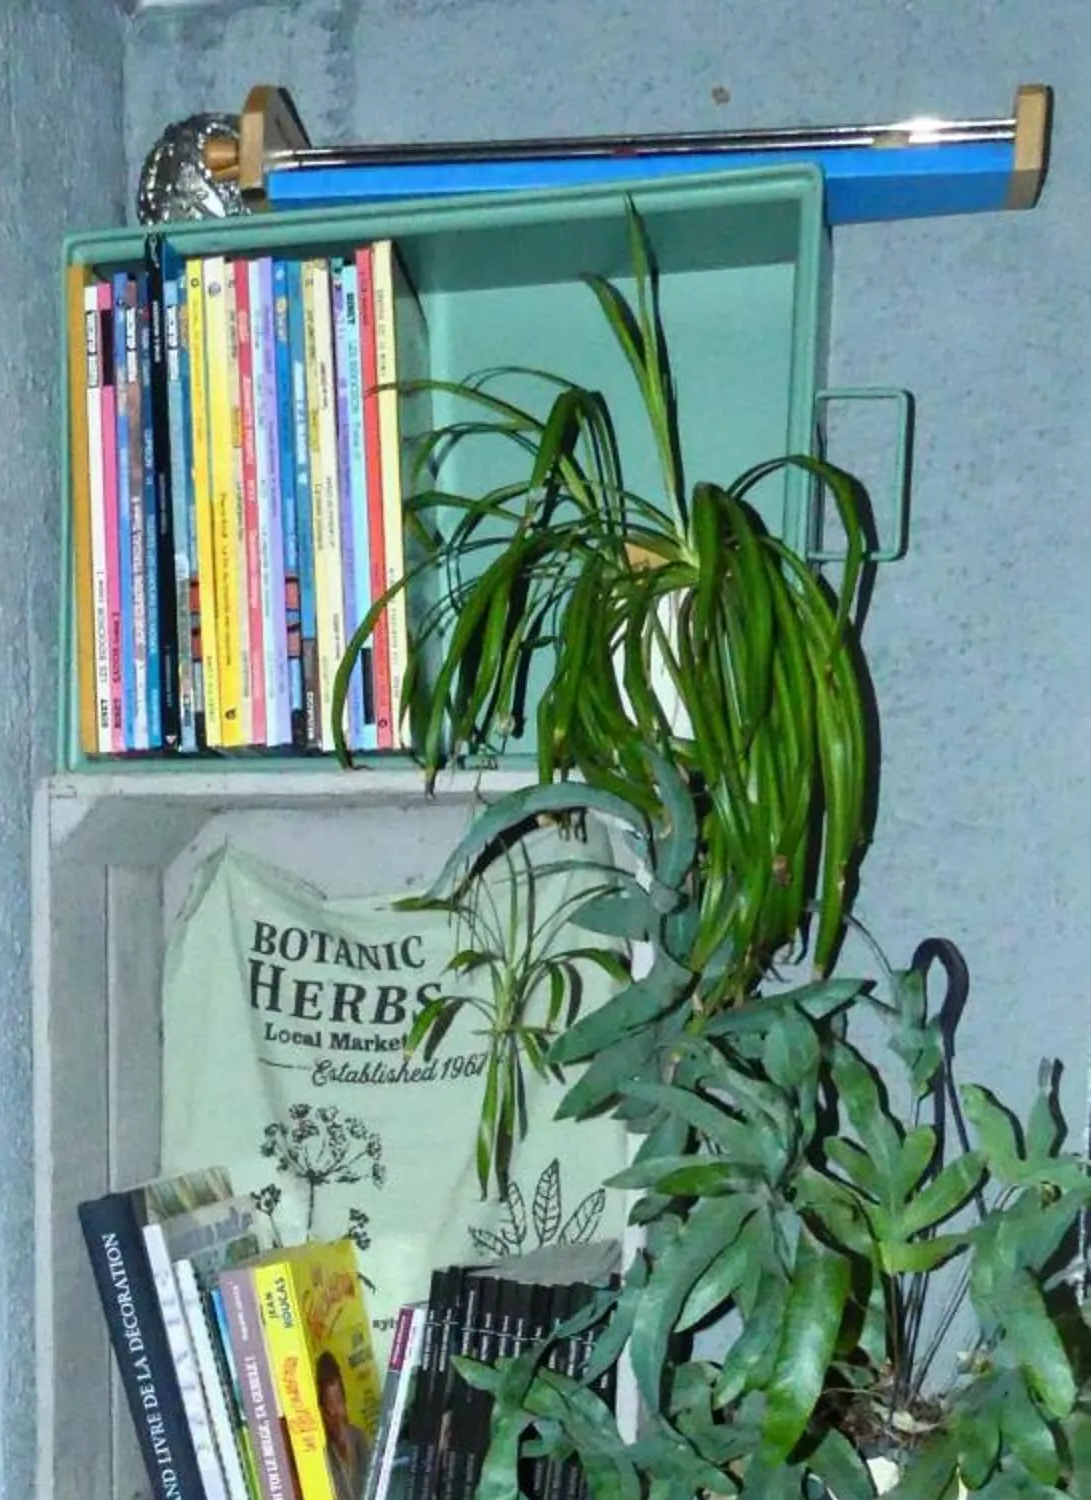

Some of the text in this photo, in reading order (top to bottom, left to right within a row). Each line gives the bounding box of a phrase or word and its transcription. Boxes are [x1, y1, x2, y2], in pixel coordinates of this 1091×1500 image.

[249, 919, 426, 971] BOTANIC
[248, 958, 443, 1025] HERBS
[264, 1022, 408, 1053] Local Market
[312, 1052, 489, 1087] Established 1967
[265, 1292, 279, 1319] JEAN
[274, 1276, 295, 1329] ROUCAS
[133, 1356, 153, 1382] LA
[140, 1383, 159, 1409] DE
[146, 1413, 172, 1465] LIVRE
